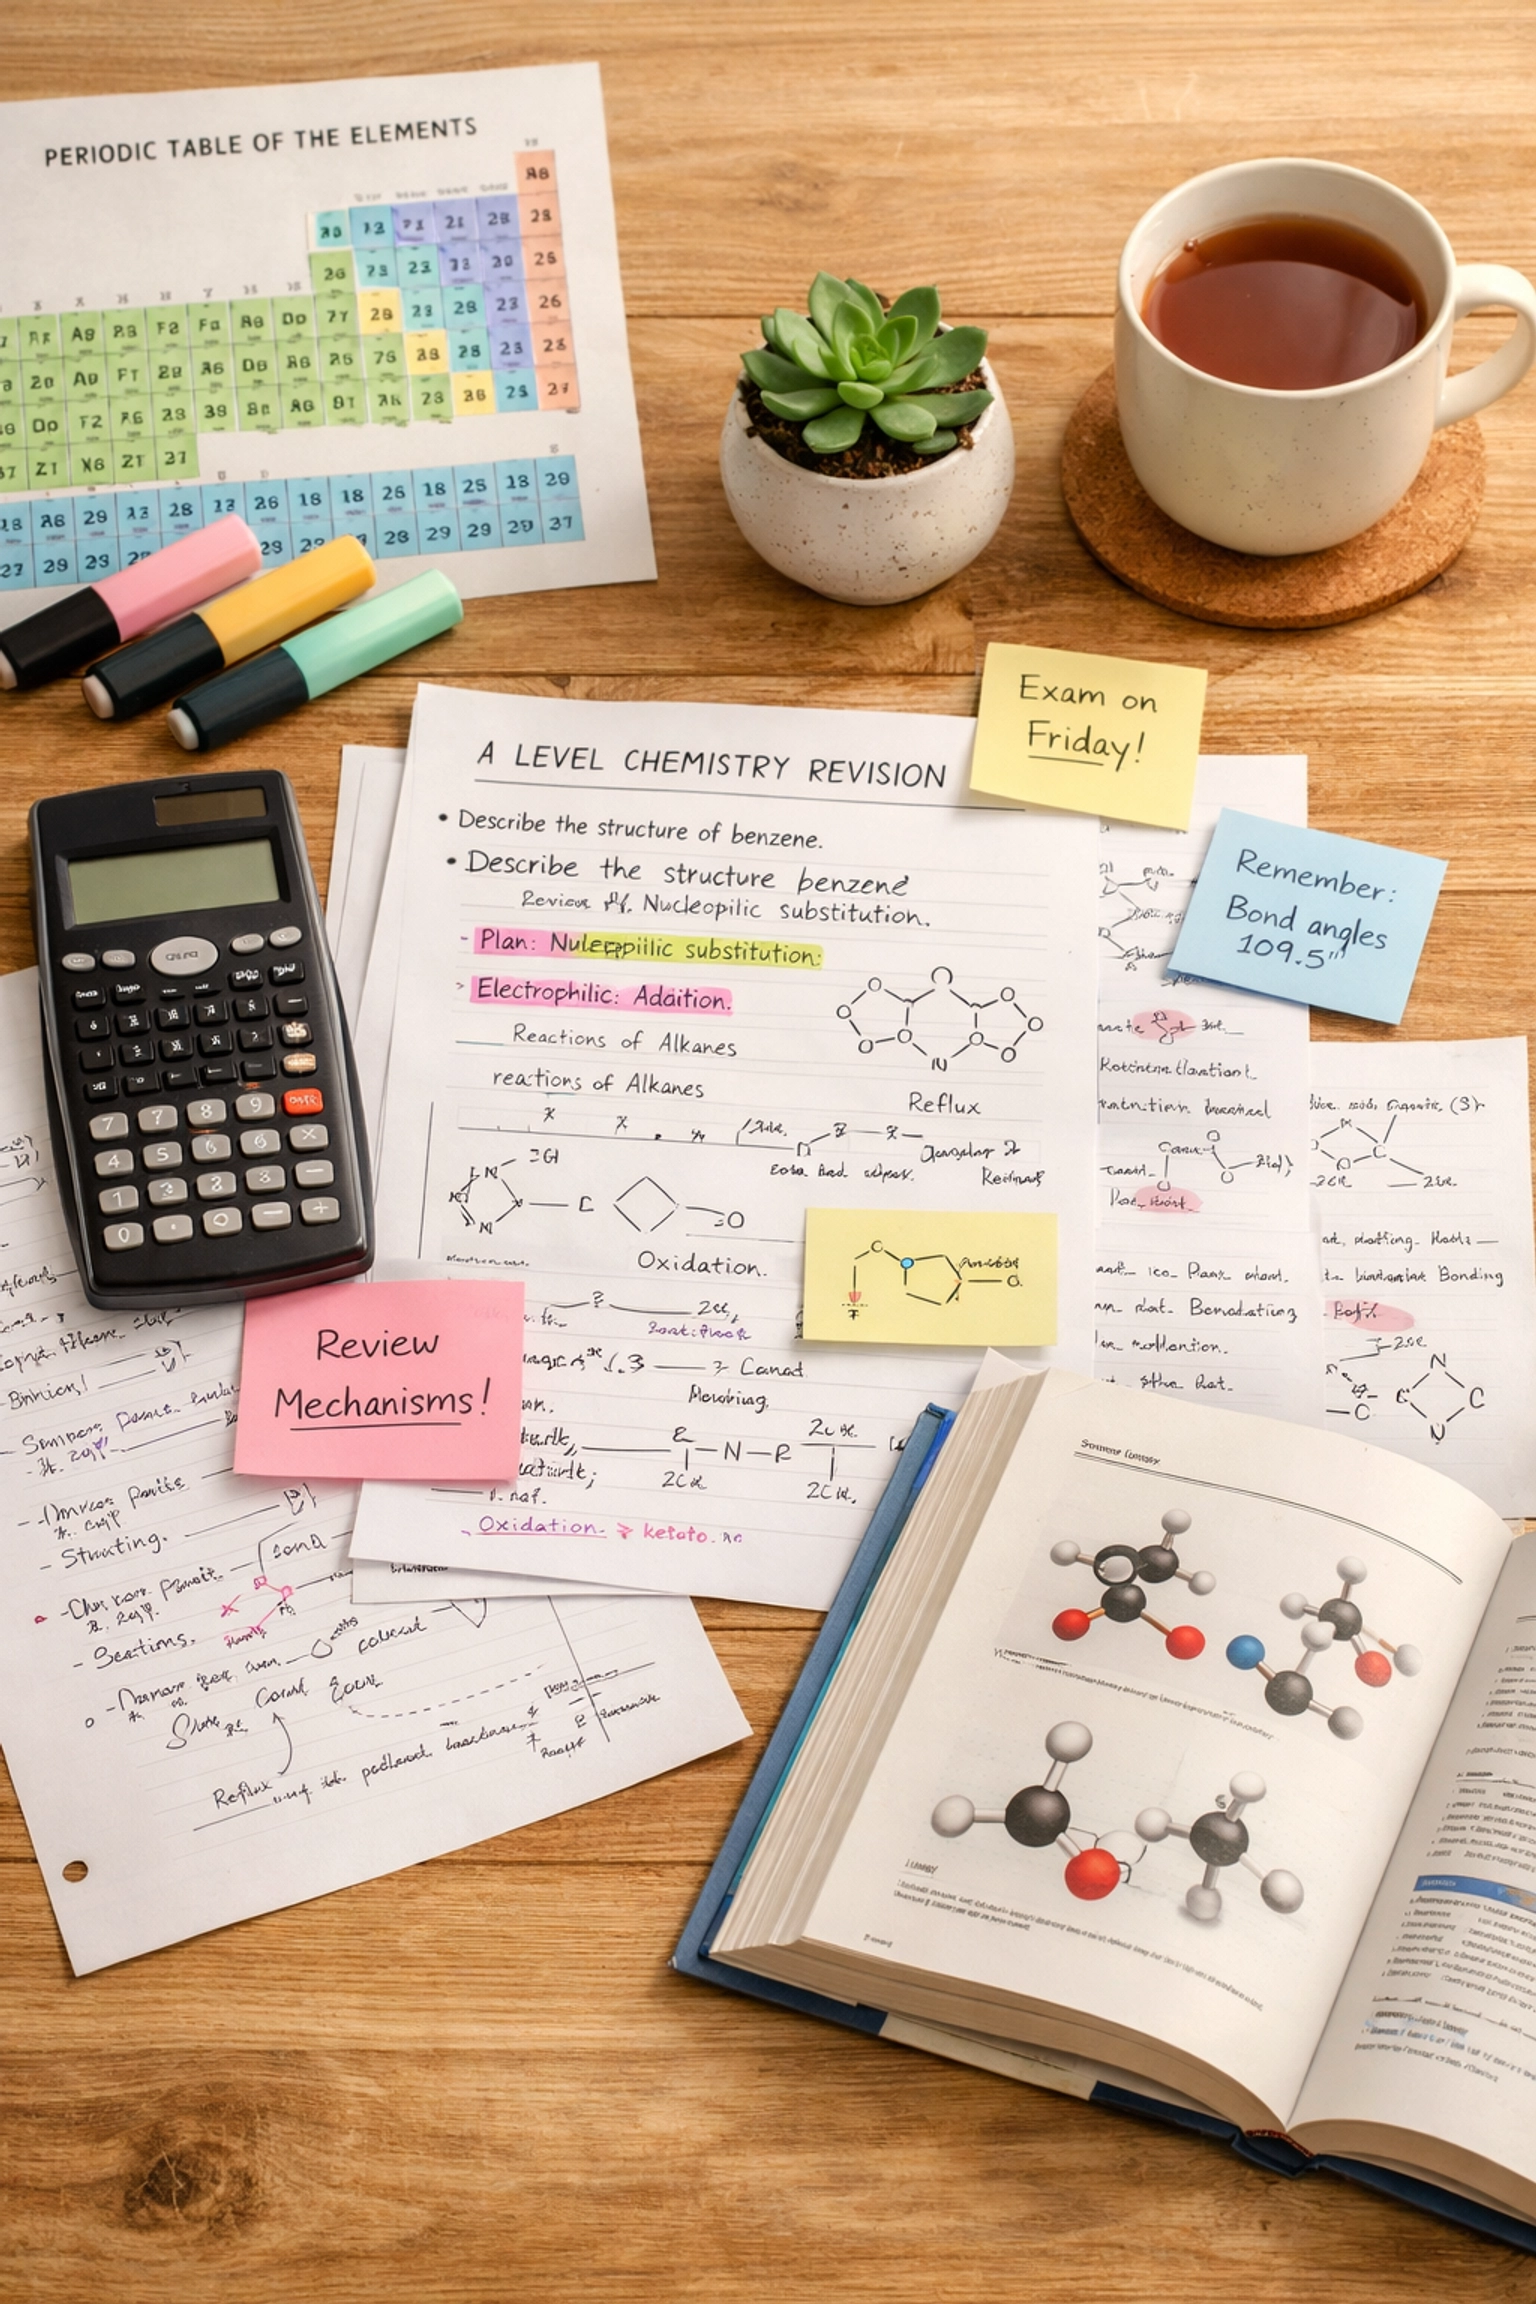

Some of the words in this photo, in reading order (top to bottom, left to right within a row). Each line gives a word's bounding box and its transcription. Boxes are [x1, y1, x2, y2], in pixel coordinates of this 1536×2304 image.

[45, 141, 157, 167] PERIODIC
[167, 135, 242, 158] TABLE
[252, 132, 283, 153] OF
[294, 128, 339, 149] THE
[350, 117, 477, 145] ELEMENTS
[1019, 673, 1105, 706] Exam
[1121, 695, 1157, 713] on
[477, 740, 494, 765] A
[515, 743, 604, 771] LEVEL
[624, 749, 790, 780] CHEMISTRY
[808, 758, 947, 789] REVISION
[1028, 719, 1145, 773] Friday!
[458, 808, 546, 833] Describe
[555, 814, 588, 835] the
[598, 818, 688, 841] structure
[698, 822, 722, 843] of
[731, 822, 823, 849] benzene.
[464, 849, 579, 877] Describe
[599, 856, 641, 880] the
[664, 863, 776, 889] structure
[1233, 848, 1396, 904] Remember:
[779, 899, 930, 927] substitution.
[1226, 894, 1297, 932] Bond
[1307, 918, 1388, 953] angles
[480, 928, 537, 952] Plan:
[477, 976, 619, 1007] Electrophilic:
[513, 1022, 606, 1049] Reactions
[620, 1029, 644, 1050] of
[658, 1031, 737, 1058] Alkanes
[592, 1073, 614, 1092] of
[625, 1072, 705, 1098] Alkanes
[908, 1091, 981, 1115] Reflux
[637, 1250, 767, 1277] Oxidation.
[317, 1328, 440, 1361] Review
[274, 1376, 491, 1424] Mechanisms!
[478, 1515, 605, 1533] Oxidation.
